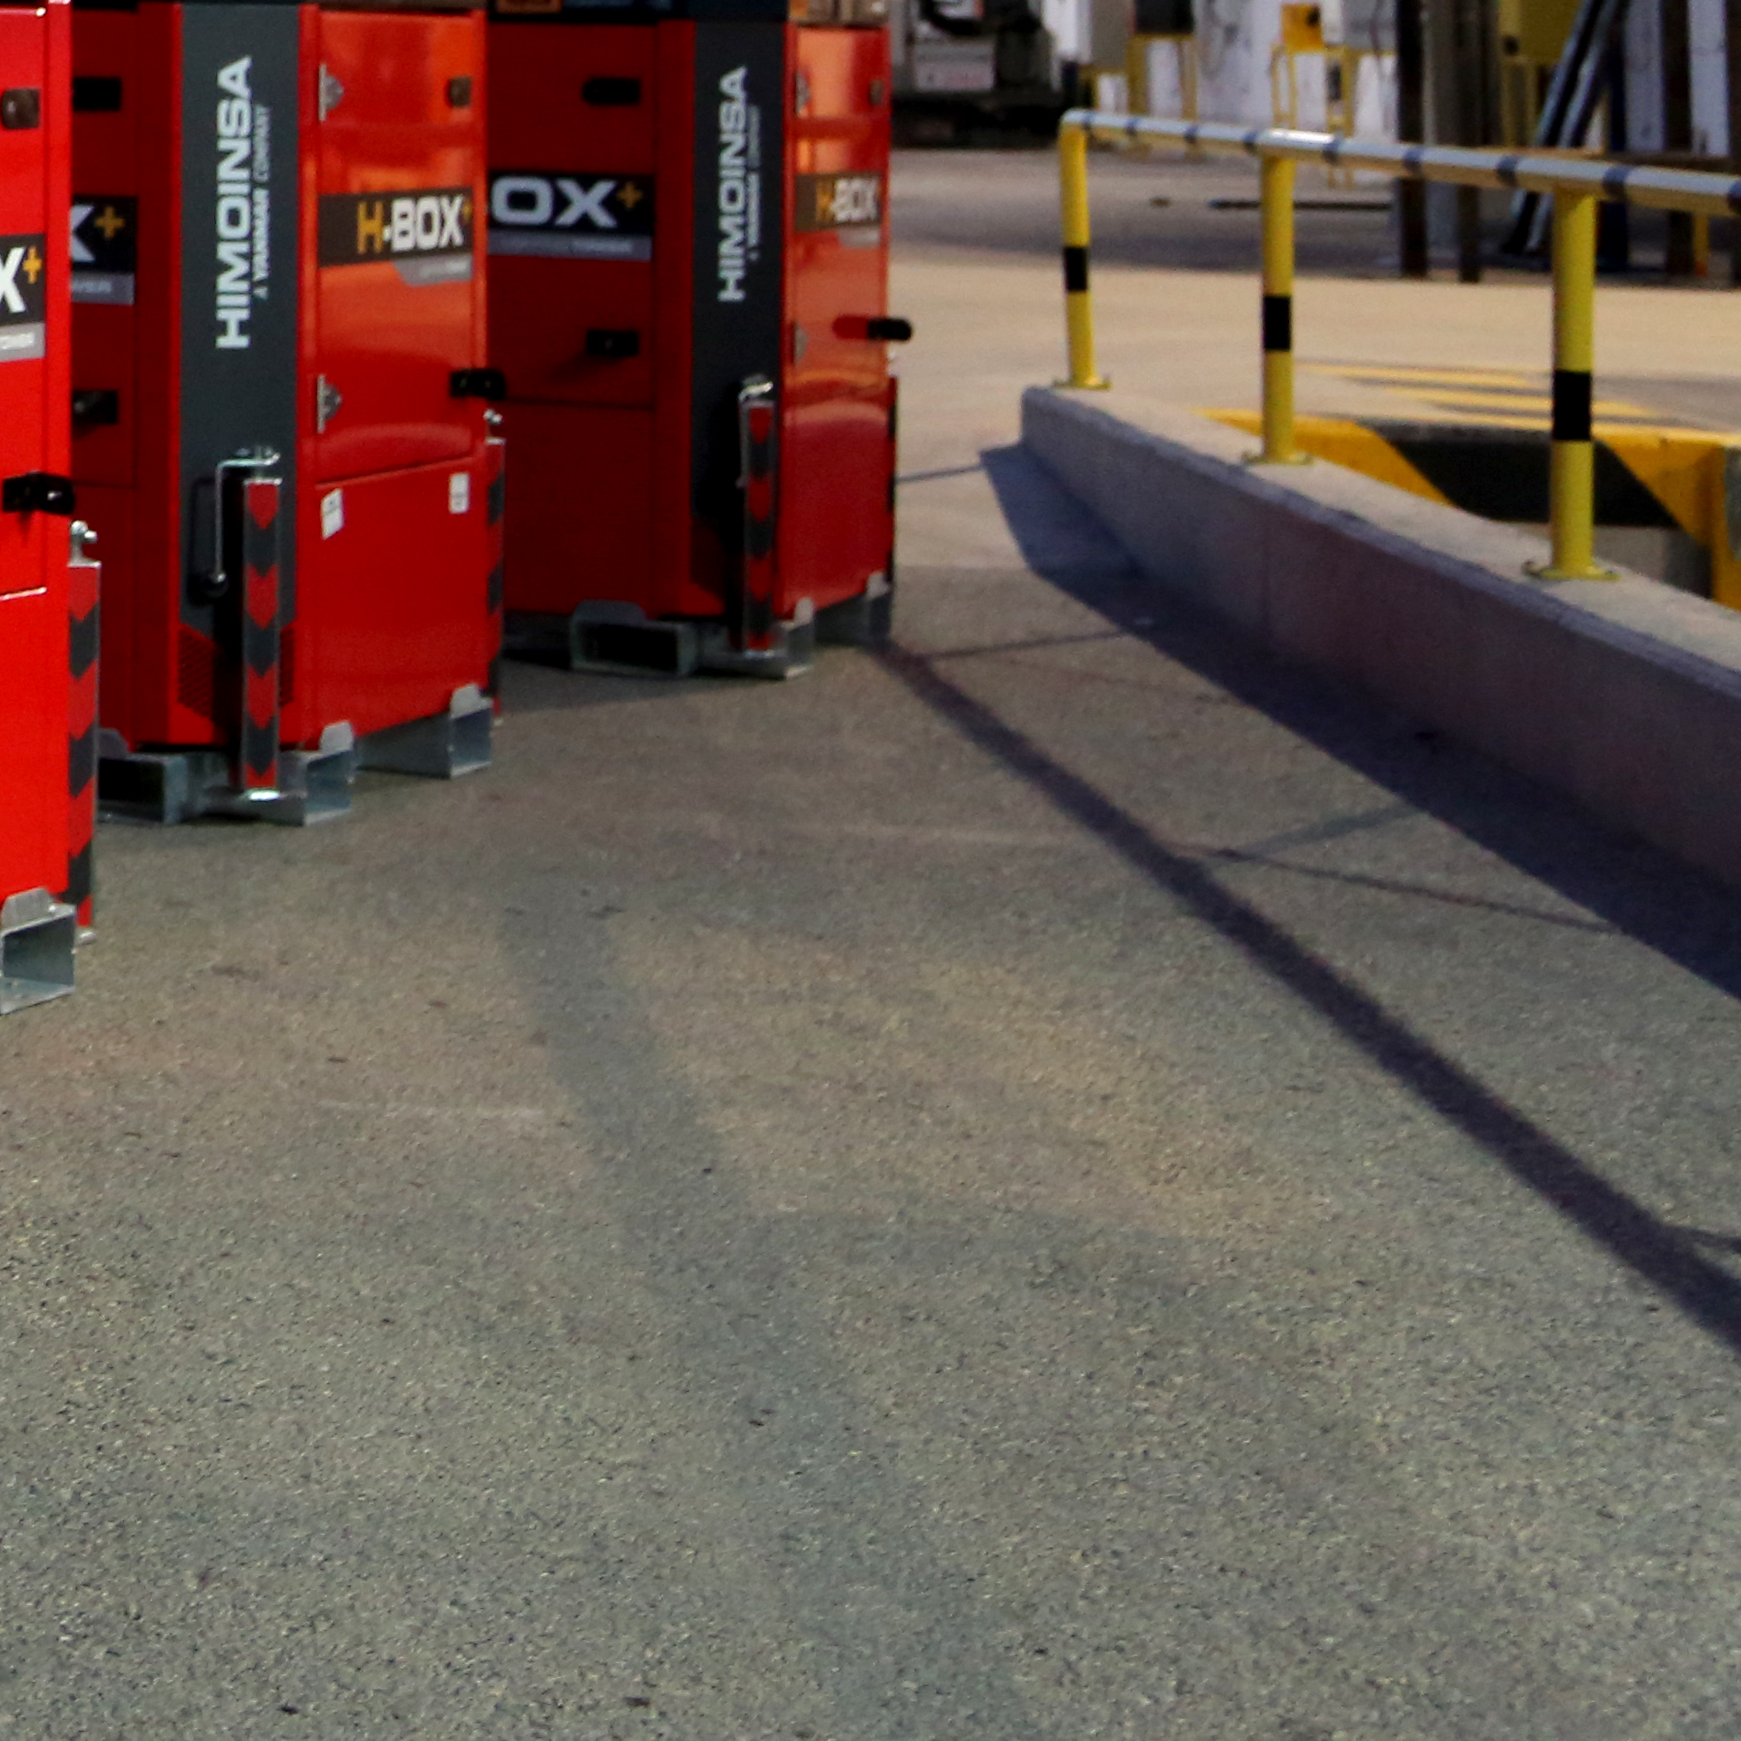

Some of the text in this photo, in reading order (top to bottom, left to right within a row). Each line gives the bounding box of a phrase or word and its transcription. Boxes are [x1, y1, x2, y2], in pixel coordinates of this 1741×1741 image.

[215, 54, 253, 350] HIMOINSA
[490, 175, 643, 228] OX+
[718, 65, 748, 303] HIMOINSA
